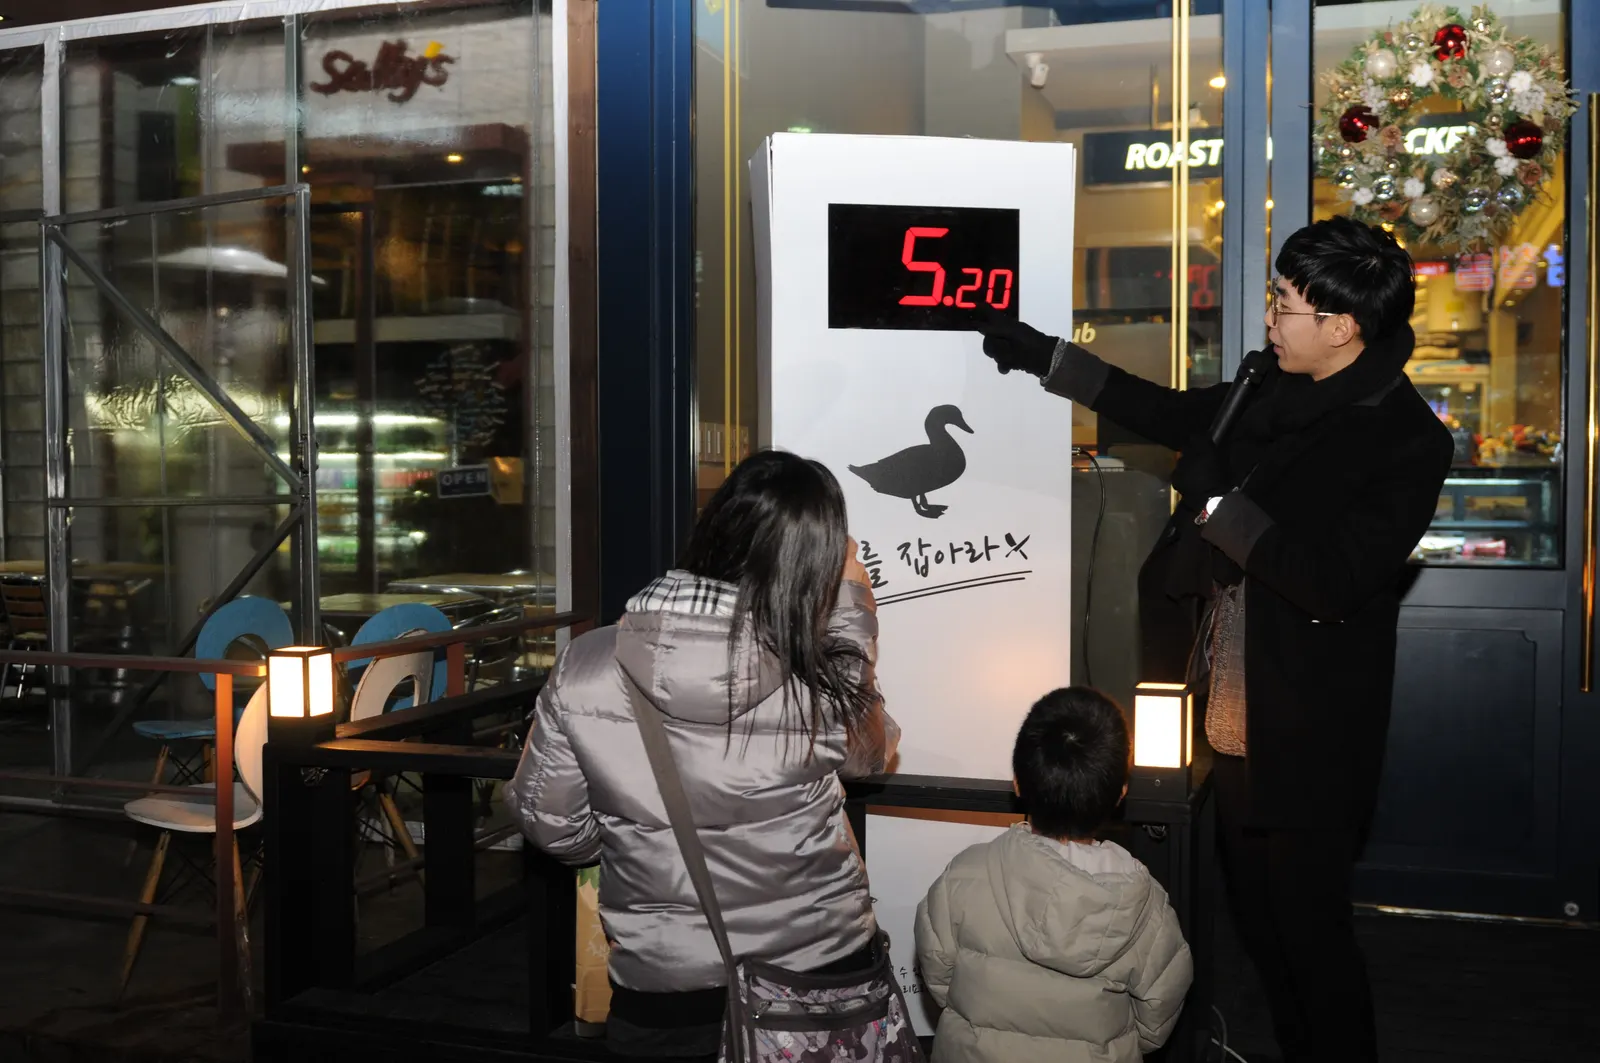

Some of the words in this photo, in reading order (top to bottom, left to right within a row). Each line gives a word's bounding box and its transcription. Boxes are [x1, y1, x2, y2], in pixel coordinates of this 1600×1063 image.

[898, 226, 1013, 310] 5.20
[441, 471, 487, 486] OPEN
[896, 535, 1000, 578] 잡아라
